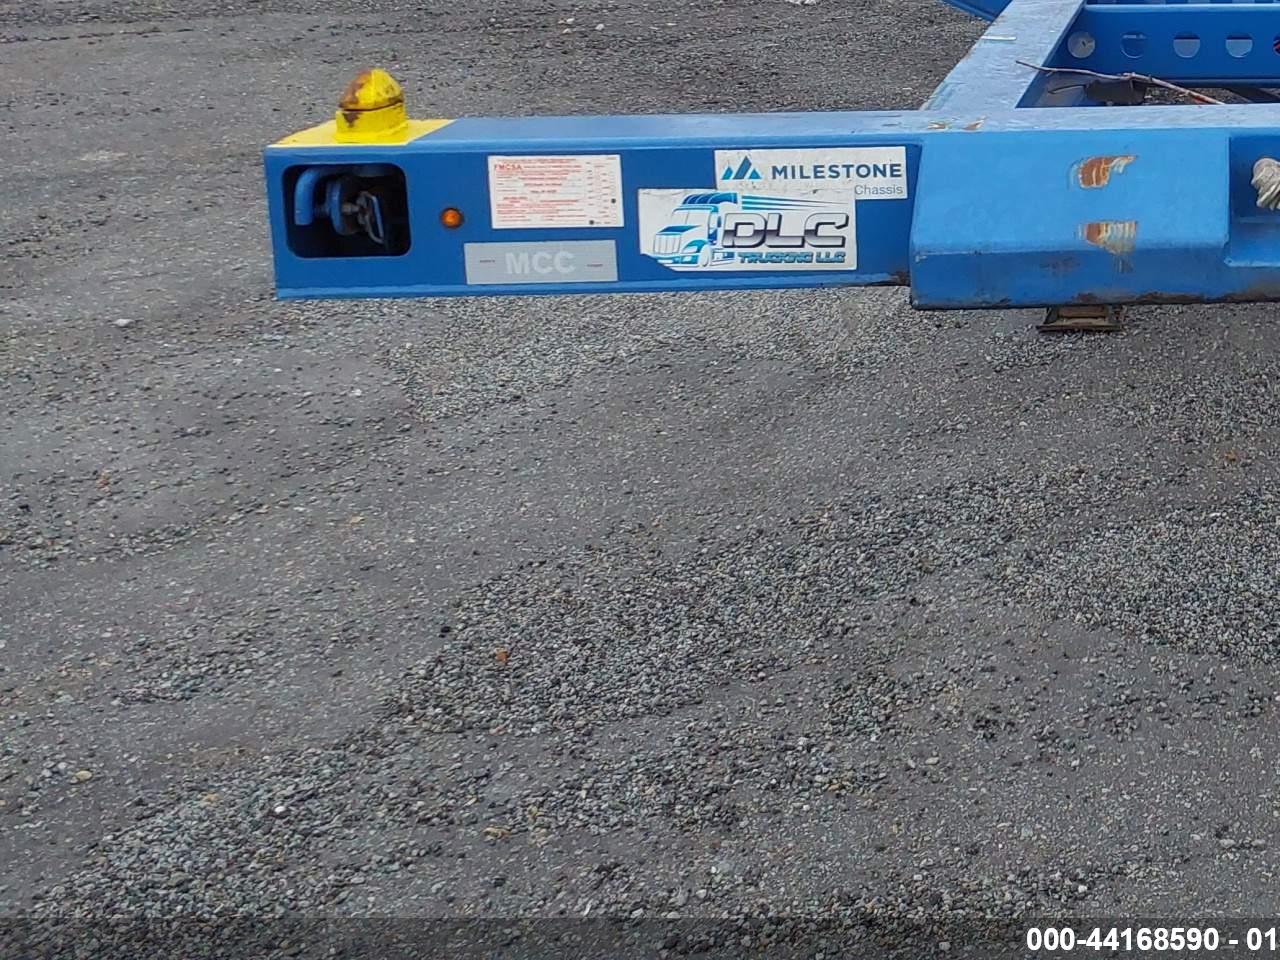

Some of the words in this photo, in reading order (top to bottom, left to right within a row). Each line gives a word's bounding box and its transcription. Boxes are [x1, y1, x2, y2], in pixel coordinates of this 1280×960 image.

[771, 163, 902, 180] MILESTONE
[854, 184, 903, 196] Chassis
[722, 213, 849, 249] DLC
[505, 251, 576, 274] MCC
[738, 251, 813, 264] TRUCKING
[815, 251, 846, 264] LLC
